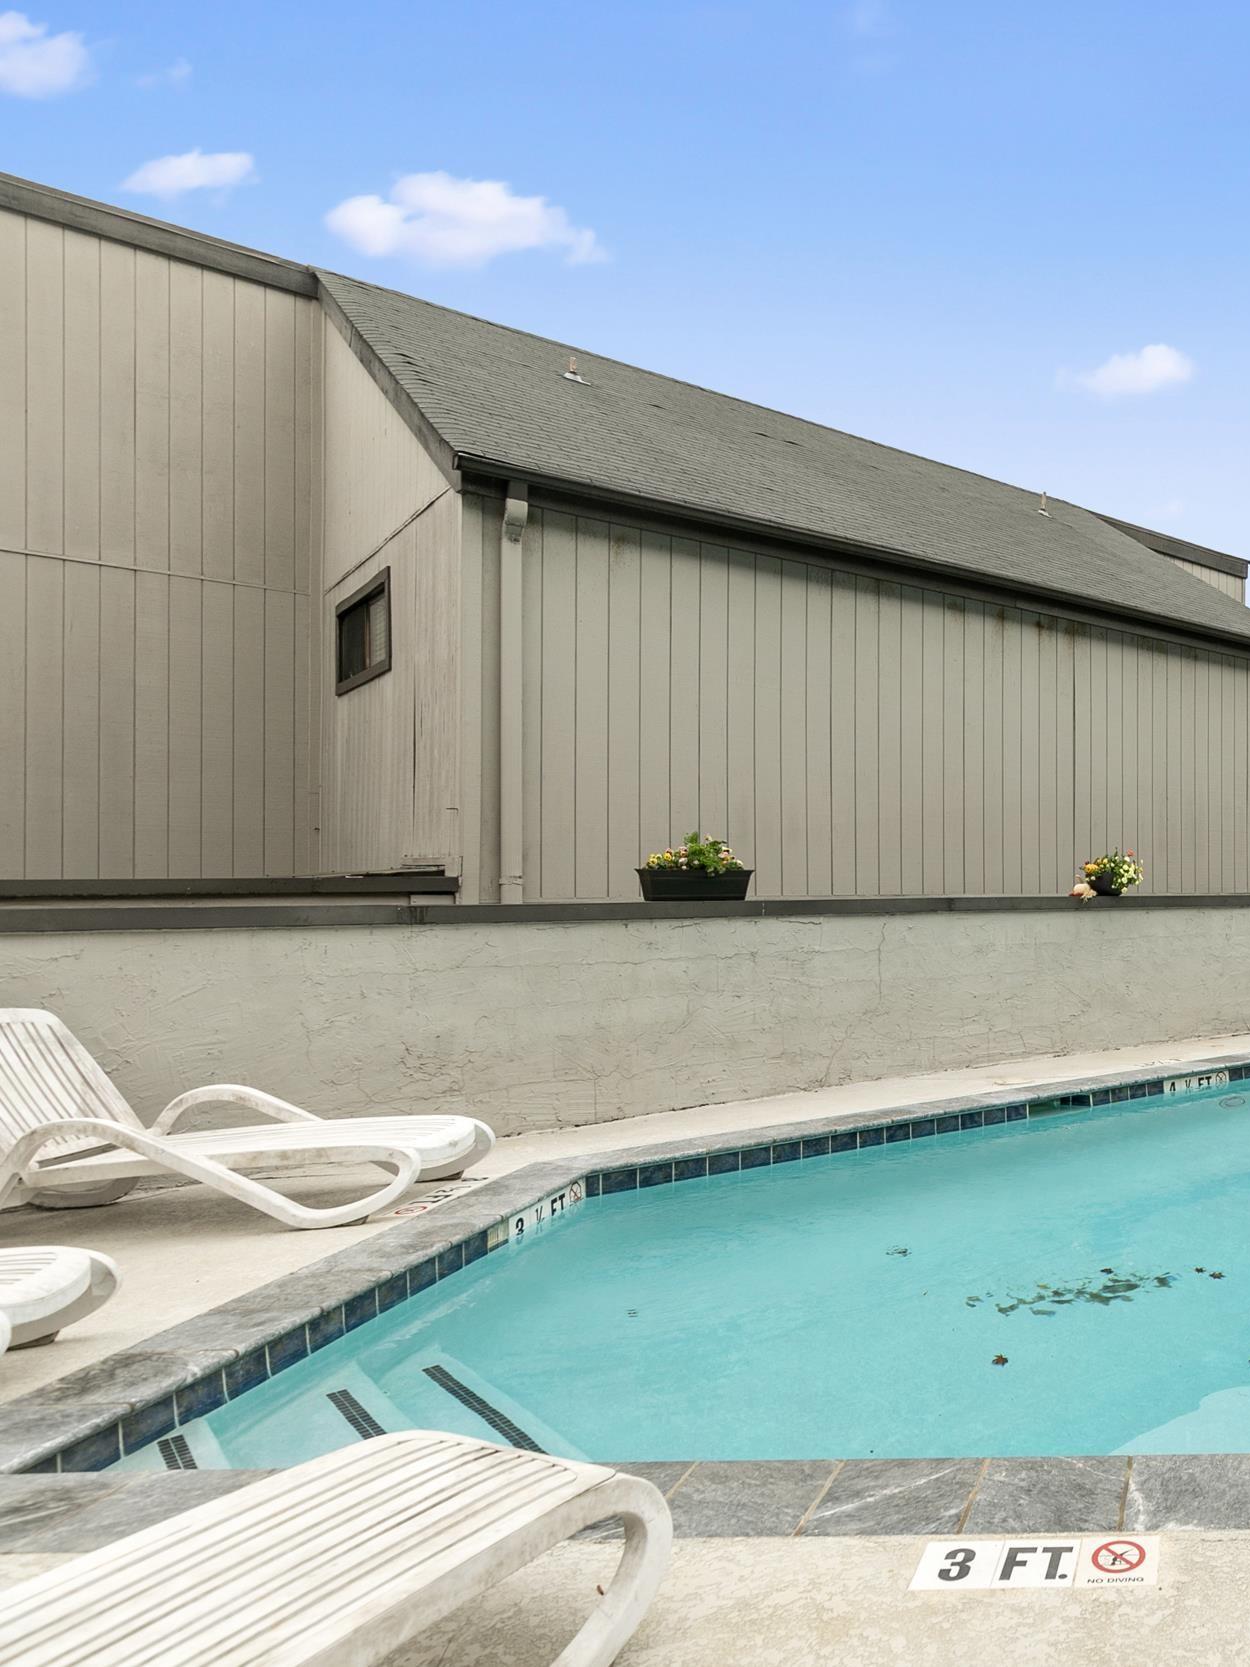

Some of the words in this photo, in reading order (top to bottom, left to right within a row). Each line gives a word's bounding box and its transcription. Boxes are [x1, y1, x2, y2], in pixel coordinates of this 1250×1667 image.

[550, 1192, 566, 1217] FT
[937, 1548, 977, 1582] 3
[998, 1546, 1074, 1581] FT.
[1107, 1576, 1144, 1584] DIVING
